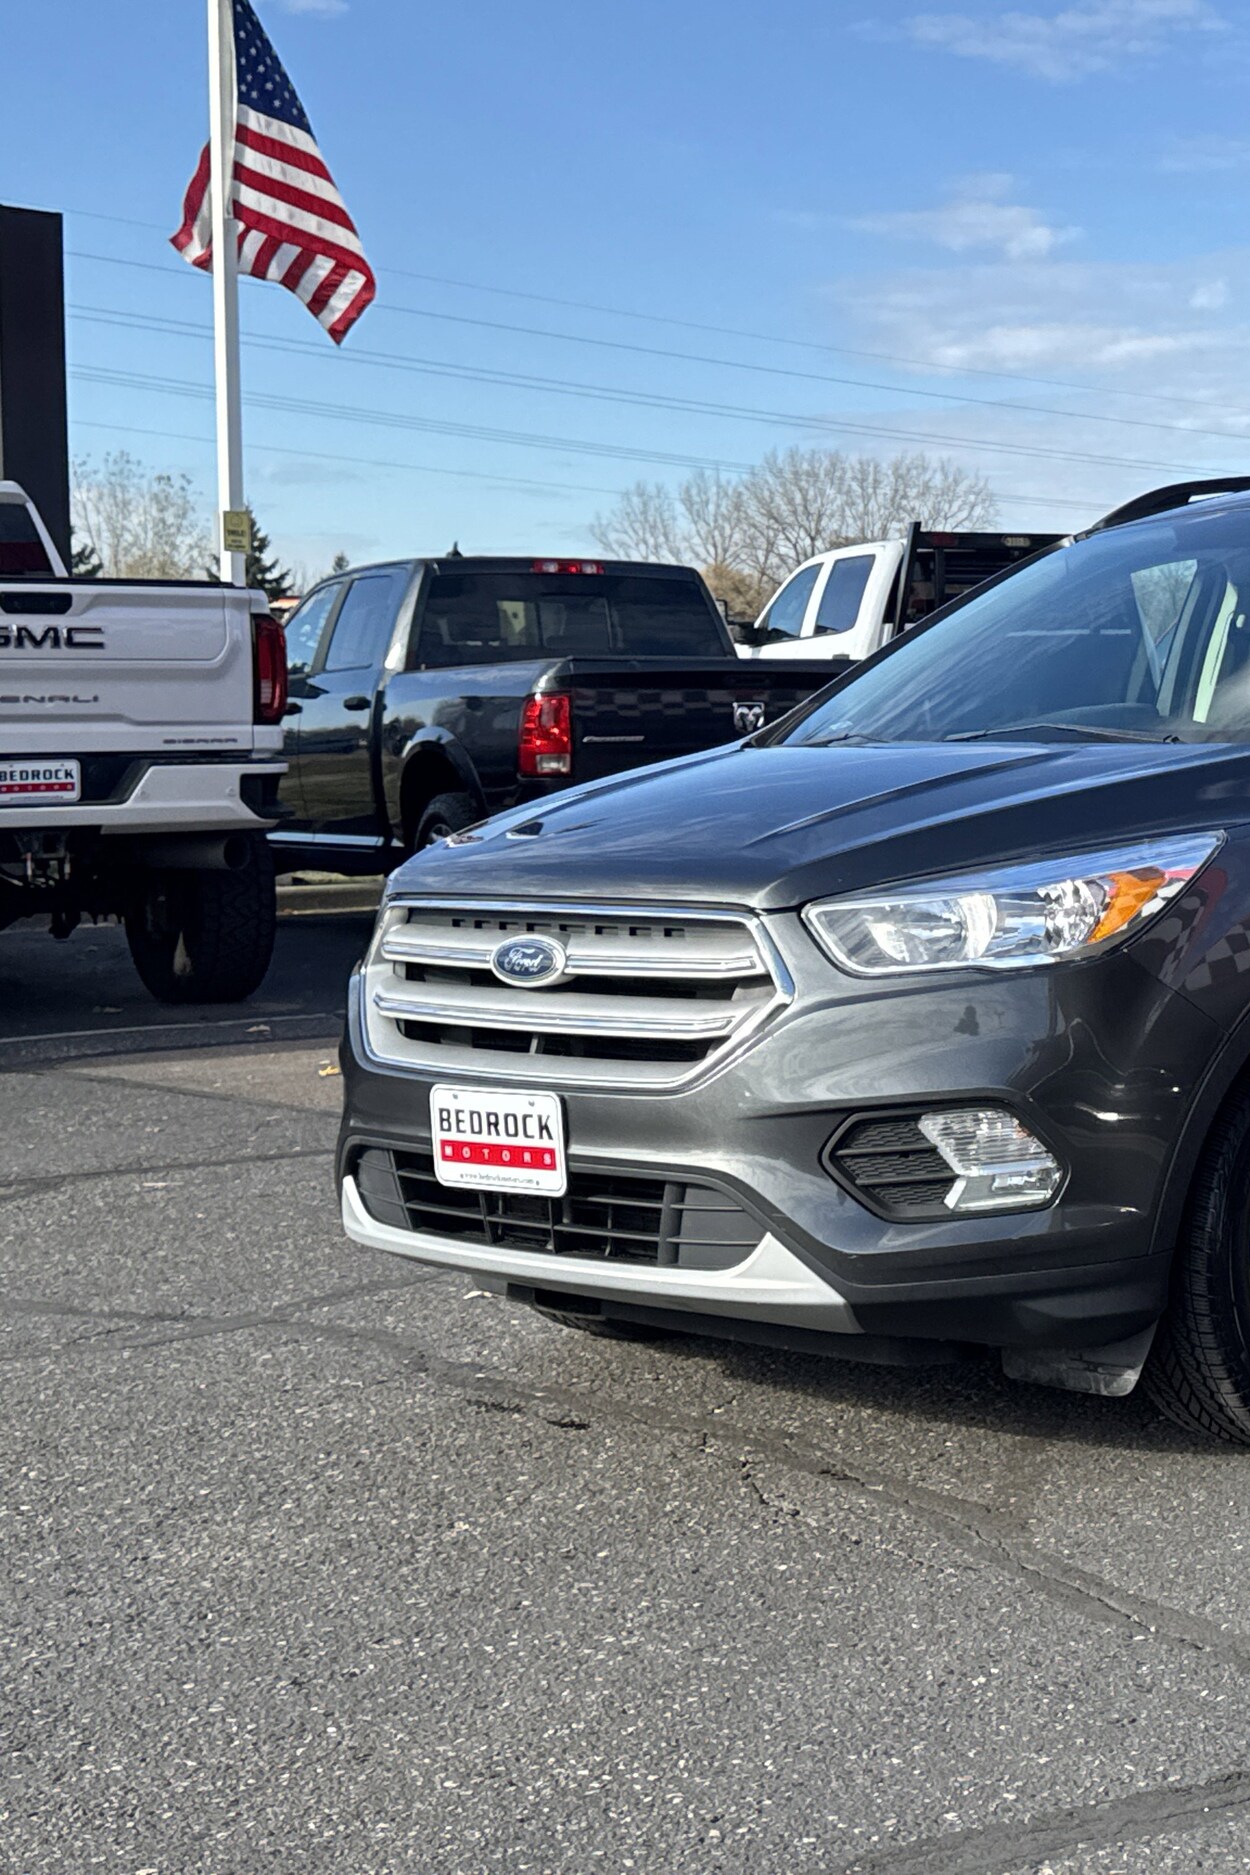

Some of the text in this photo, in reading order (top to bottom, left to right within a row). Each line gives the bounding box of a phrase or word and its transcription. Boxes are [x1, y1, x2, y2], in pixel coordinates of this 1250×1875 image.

[0, 624, 105, 649] MC
[0, 769, 75, 782] BEDROCK
[504, 946, 543, 972] Ford
[438, 1107, 554, 1140] BEDROCK
[444, 1145, 552, 1165] MOTORS
